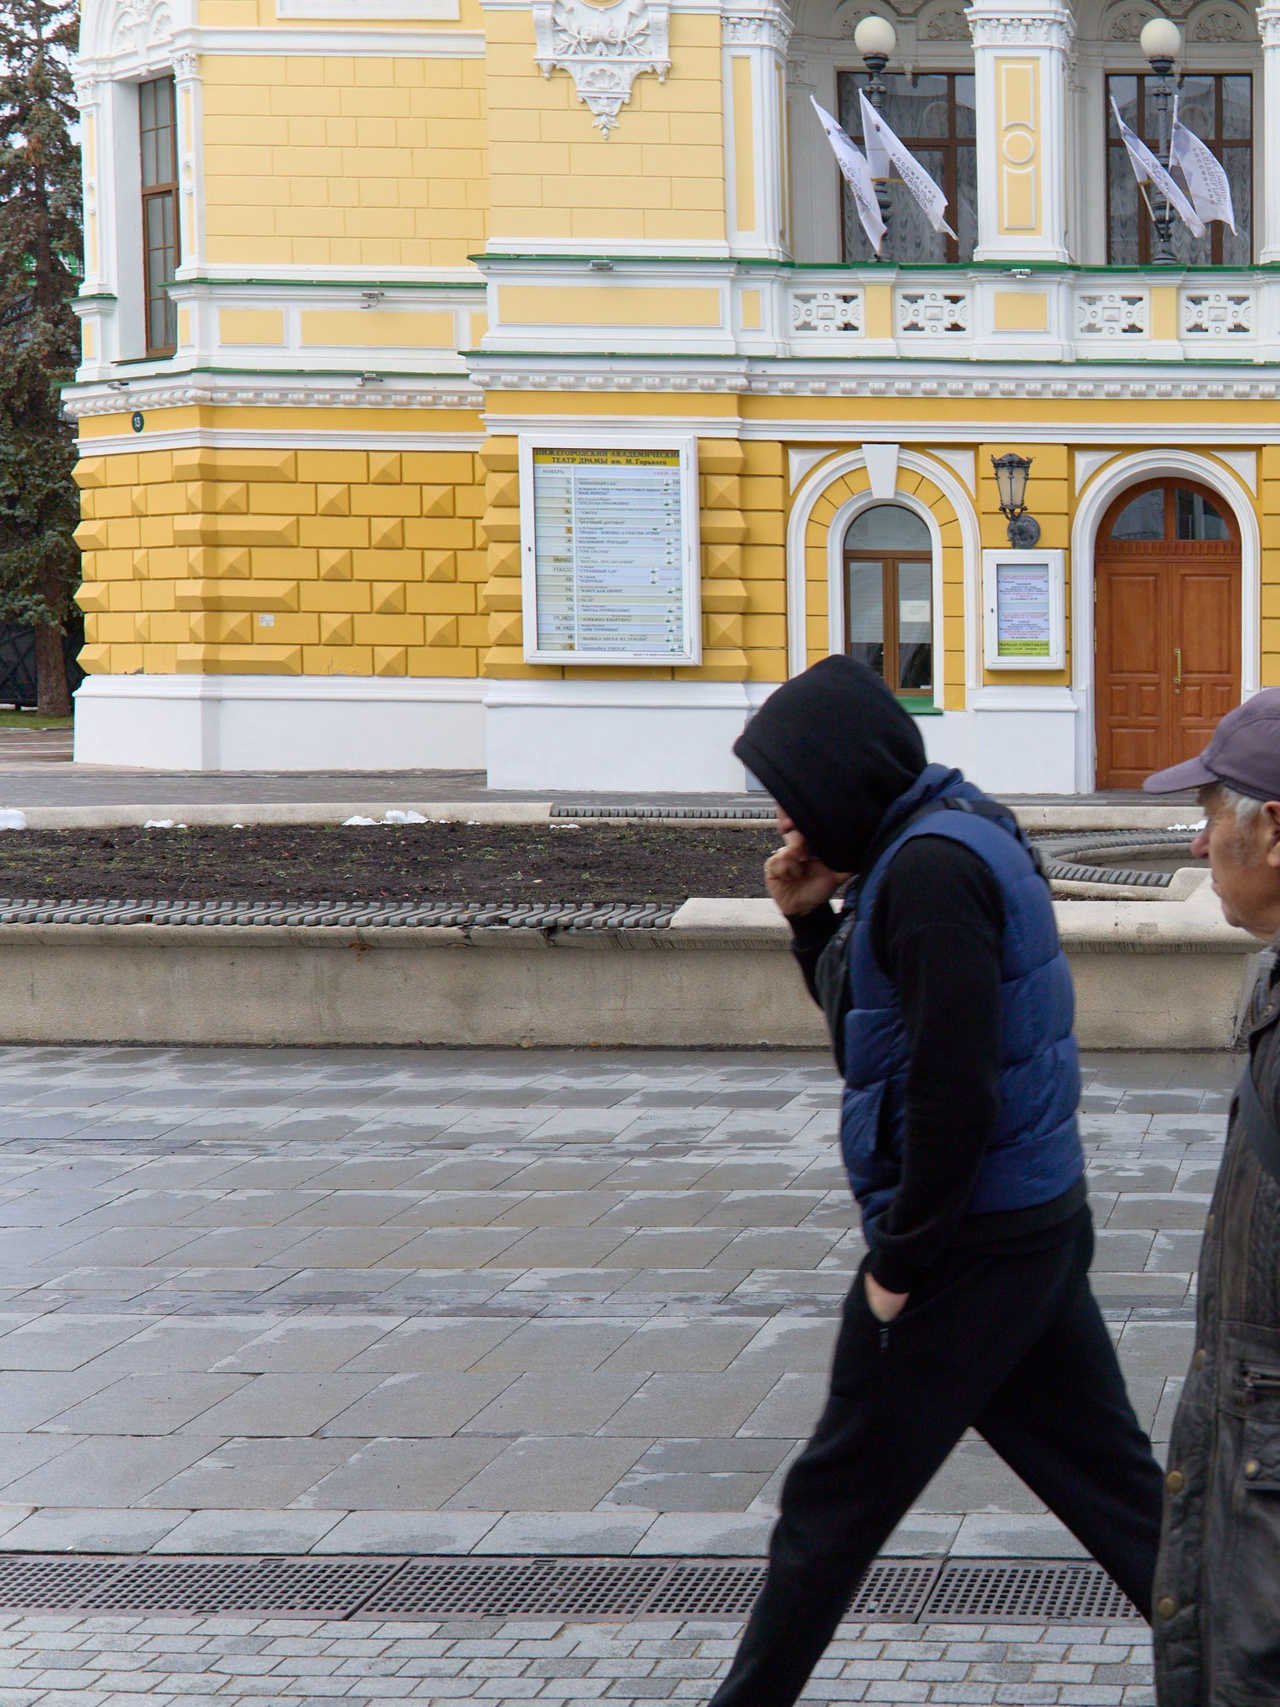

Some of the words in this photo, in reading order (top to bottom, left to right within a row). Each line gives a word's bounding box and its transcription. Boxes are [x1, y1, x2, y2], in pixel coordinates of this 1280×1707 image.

[536, 449, 608, 457] НИЖЕГОРОДСКИЙ
[551, 456, 576, 464] ТЕАТР
[578, 457, 608, 465] ДРАМЫ
[635, 458, 667, 466] Горького
